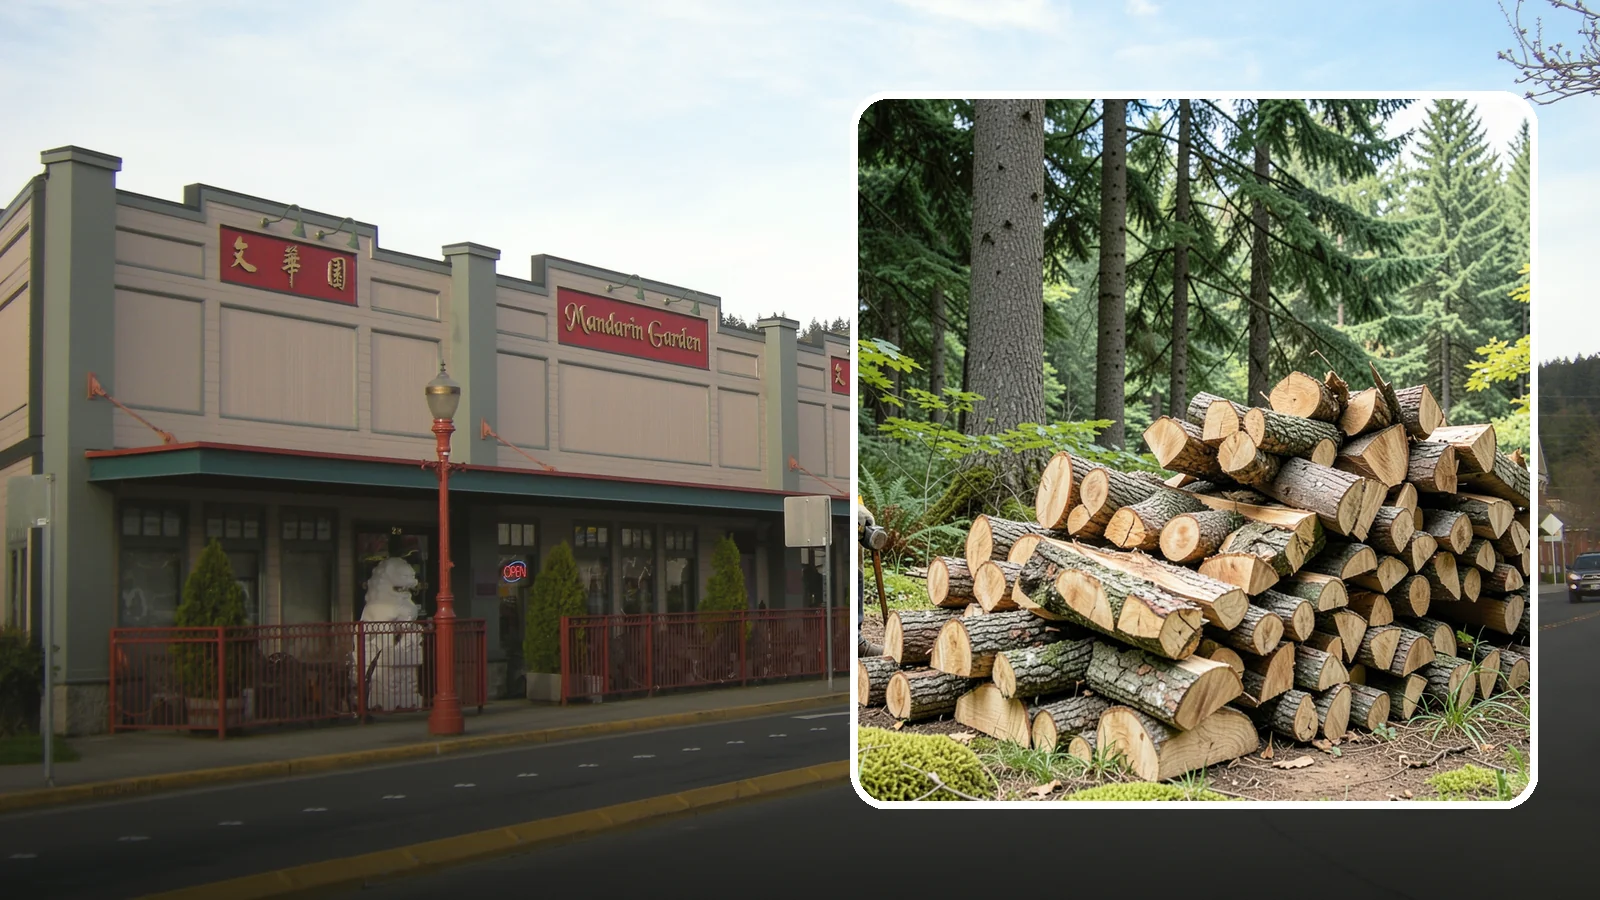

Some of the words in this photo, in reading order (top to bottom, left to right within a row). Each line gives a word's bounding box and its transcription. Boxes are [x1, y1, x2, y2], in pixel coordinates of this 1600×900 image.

[231, 235, 346, 291] 文華園
[564, 302, 644, 341] Mandarin
[648, 320, 702, 352] Garden
[503, 565, 527, 578] OPEN
